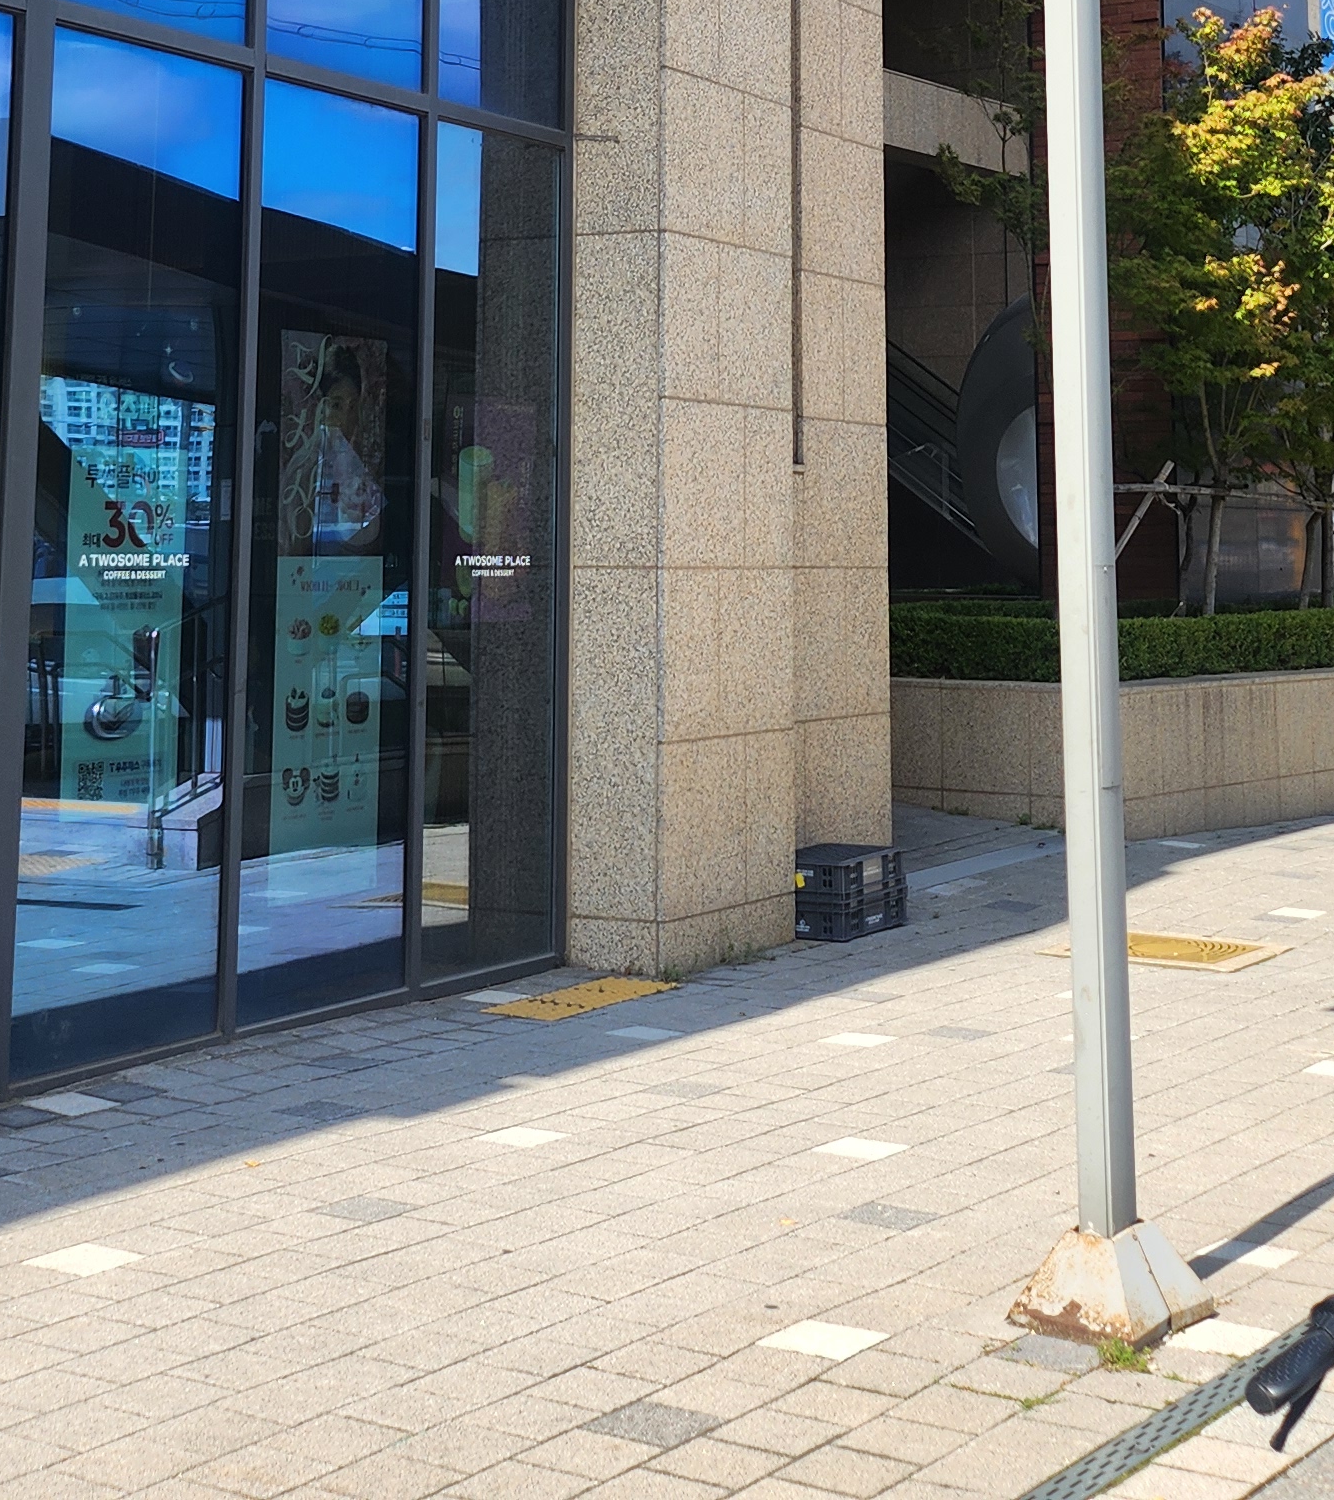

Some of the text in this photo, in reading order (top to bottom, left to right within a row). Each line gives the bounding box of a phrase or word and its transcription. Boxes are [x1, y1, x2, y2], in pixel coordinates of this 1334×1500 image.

[79, 554, 190, 566] A TWOSOME PLACE
[455, 555, 531, 566] A TWOSOME PLACE
[103, 570, 130, 580] COFFEE
[137, 570, 166, 580] DESSERT
